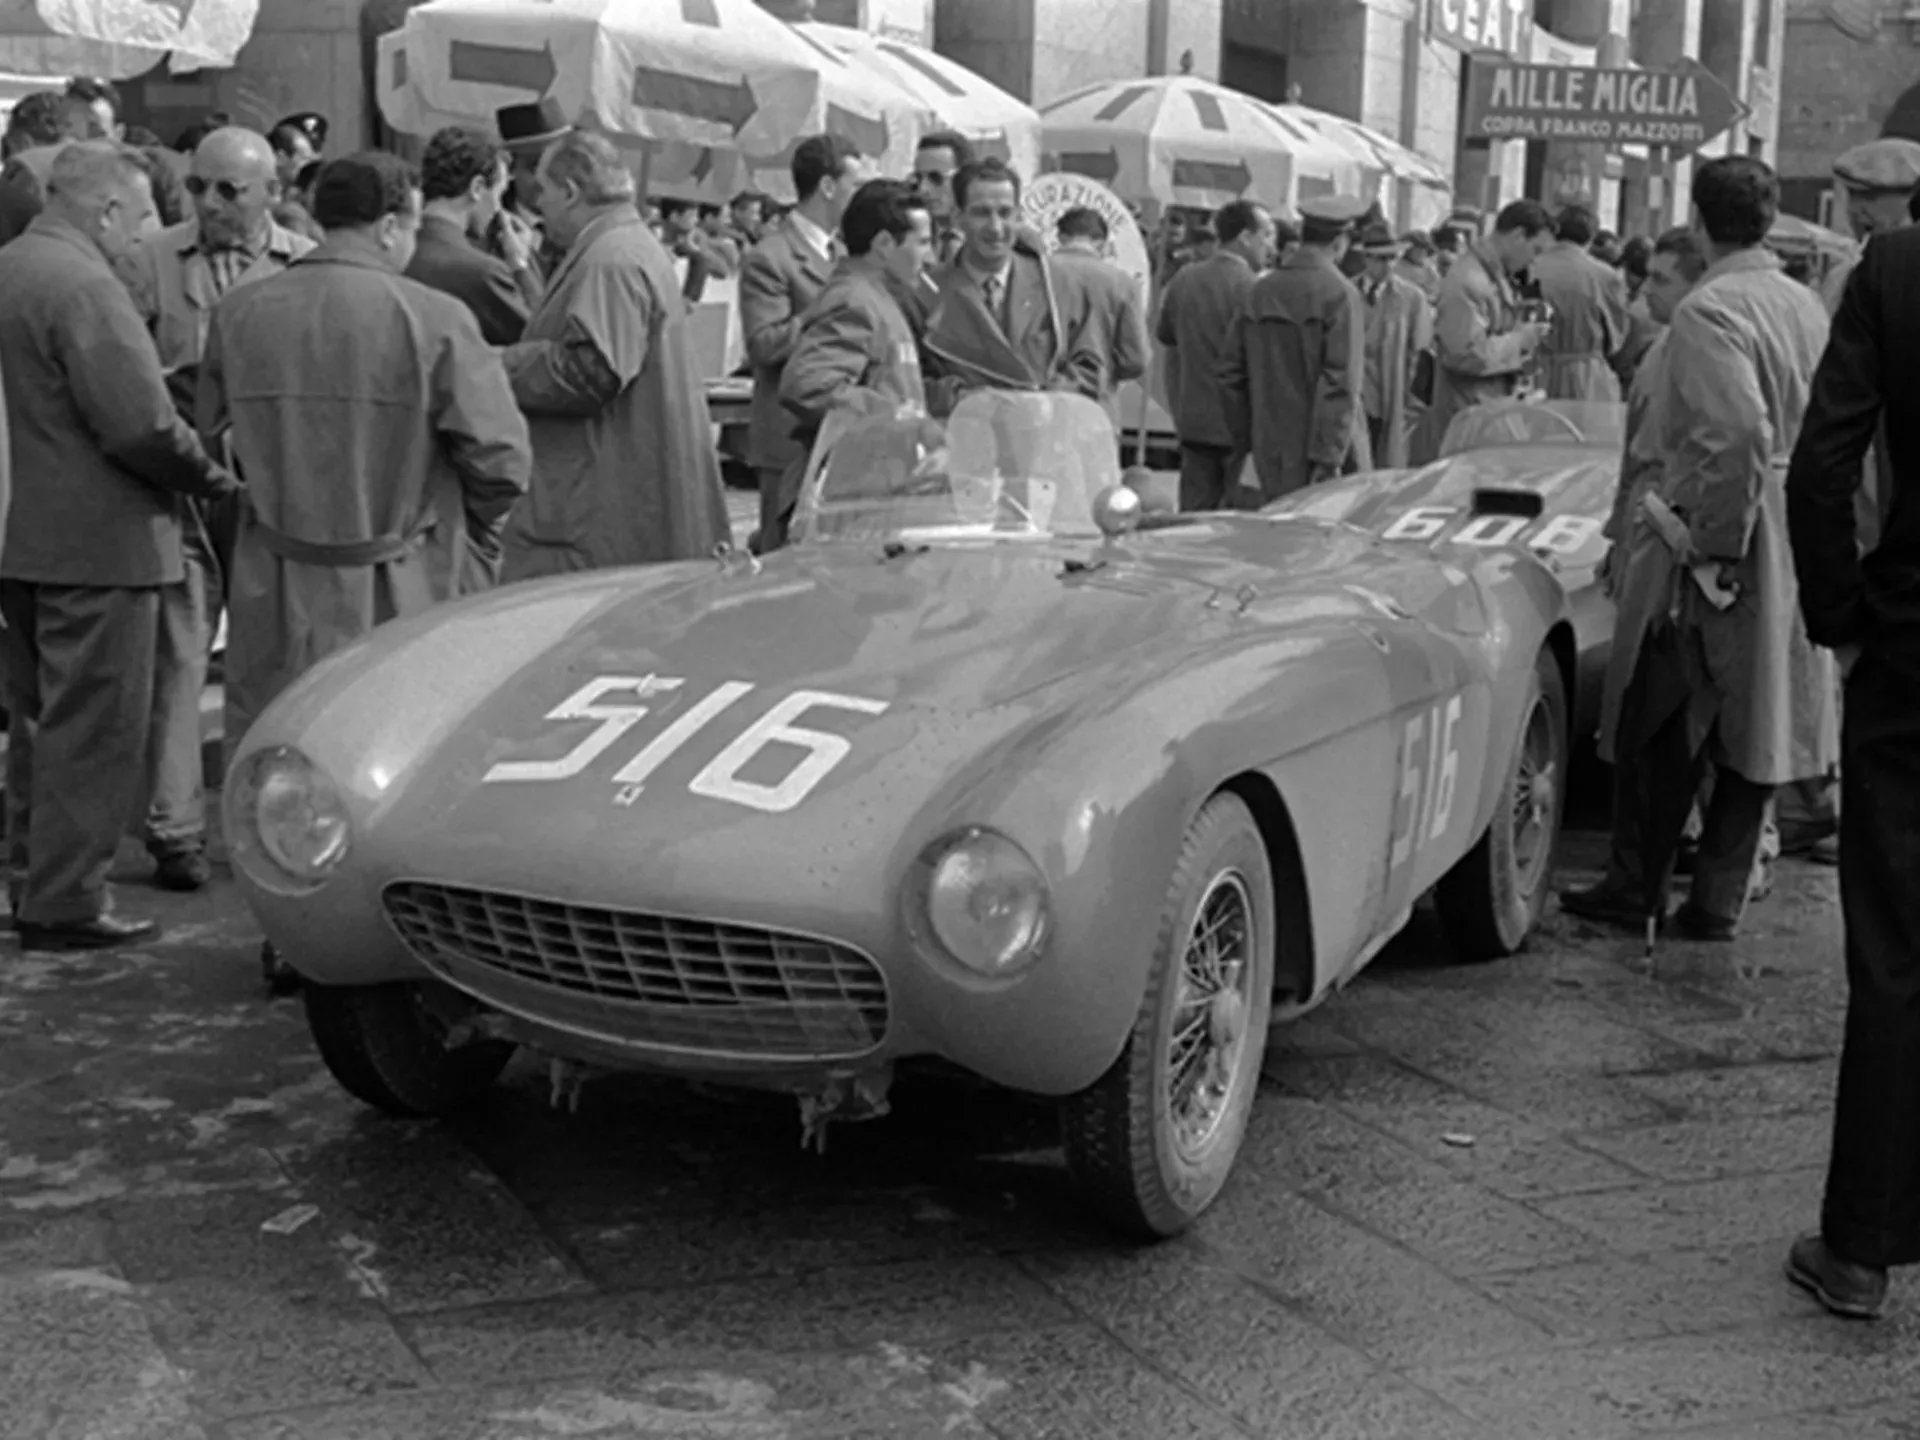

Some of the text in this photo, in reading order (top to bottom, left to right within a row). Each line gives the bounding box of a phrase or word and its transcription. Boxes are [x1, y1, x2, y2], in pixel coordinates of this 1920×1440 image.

[1491, 69, 1697, 115] MILLE MIGLIA
[1481, 116, 1536, 134] COPPA
[1541, 117, 1611, 138] FRANCO
[1381, 507, 1602, 554] 608
[481, 674, 891, 813] 516
[1390, 694, 1462, 870] 516
